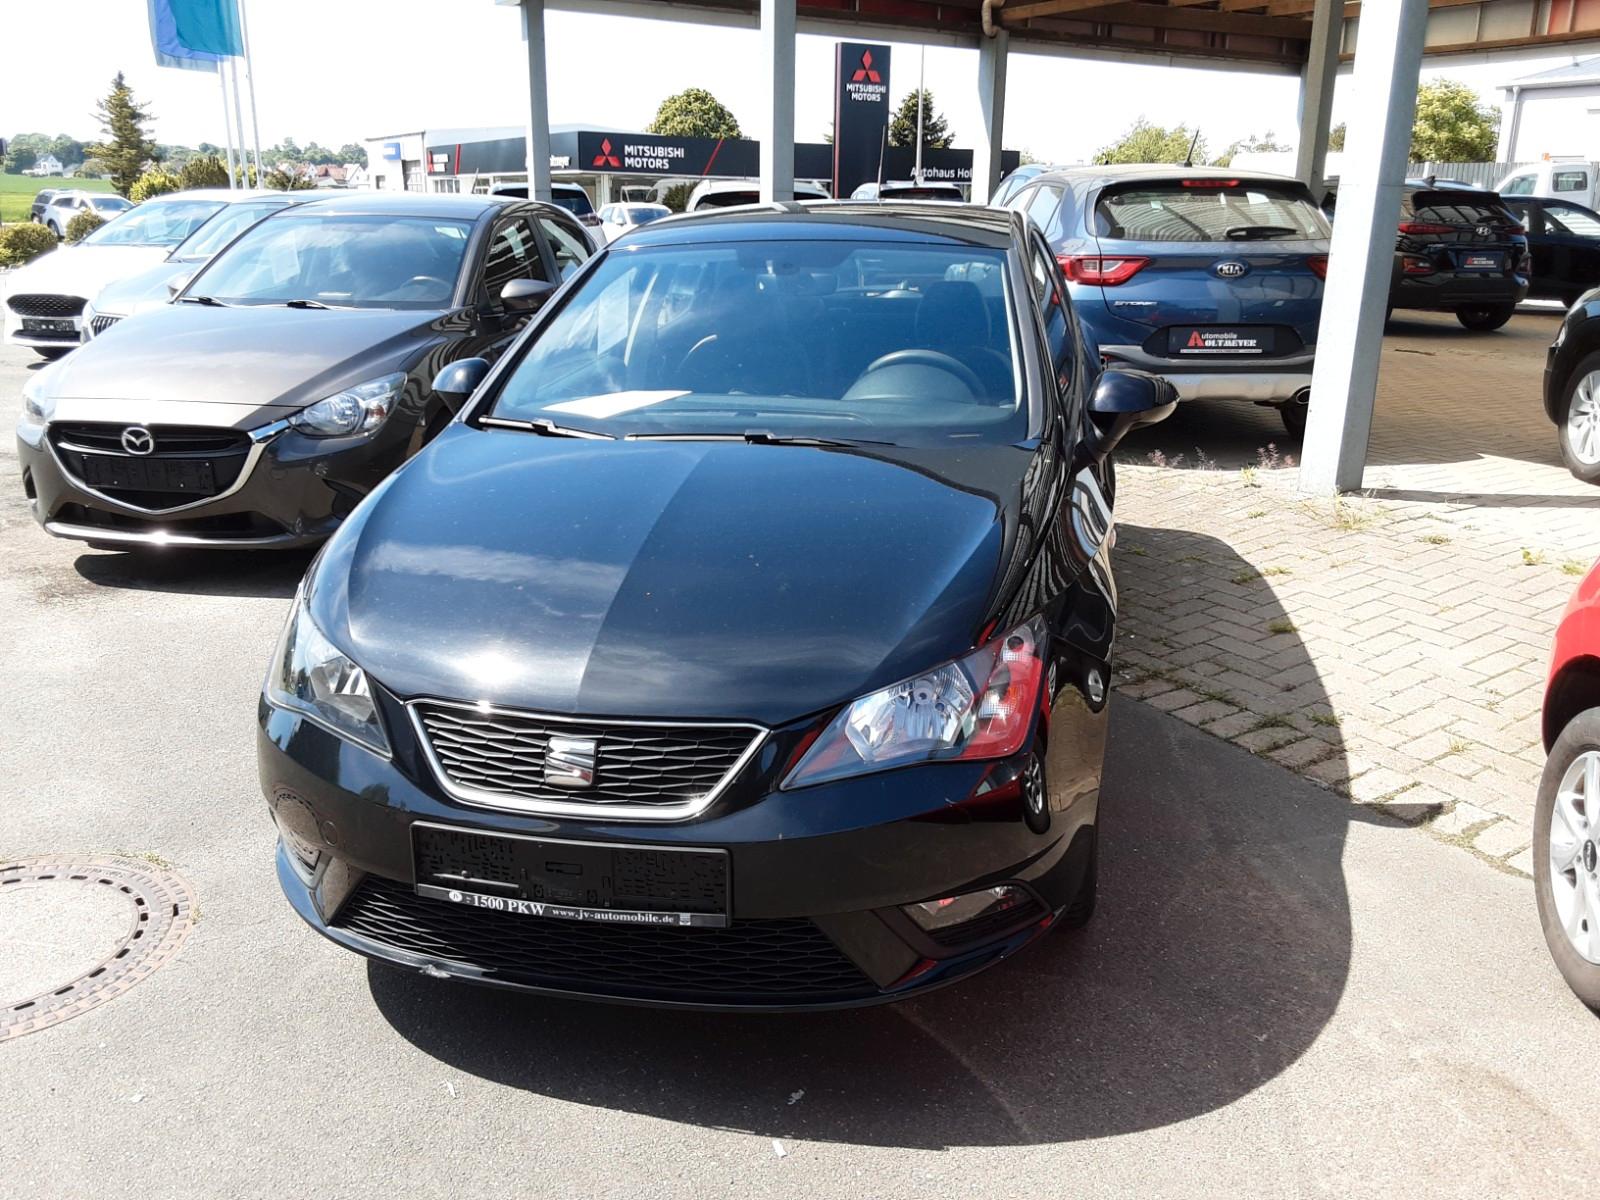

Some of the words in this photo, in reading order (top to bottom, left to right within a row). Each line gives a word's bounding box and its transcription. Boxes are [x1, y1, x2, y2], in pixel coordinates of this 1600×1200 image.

[846, 83, 886, 94] MITSUBISHI
[851, 92, 881, 102] MOTORS
[624, 145, 685, 158] MITSUBISHI
[624, 157, 669, 169] MOTORS
[910, 166, 955, 178] Atohaus
[1222, 264, 1241, 275] KIA
[473, 895, 504, 910] 1500
[507, 900, 545, 916] PKW
[552, 908, 675, 924] www.jv-automobile.de
